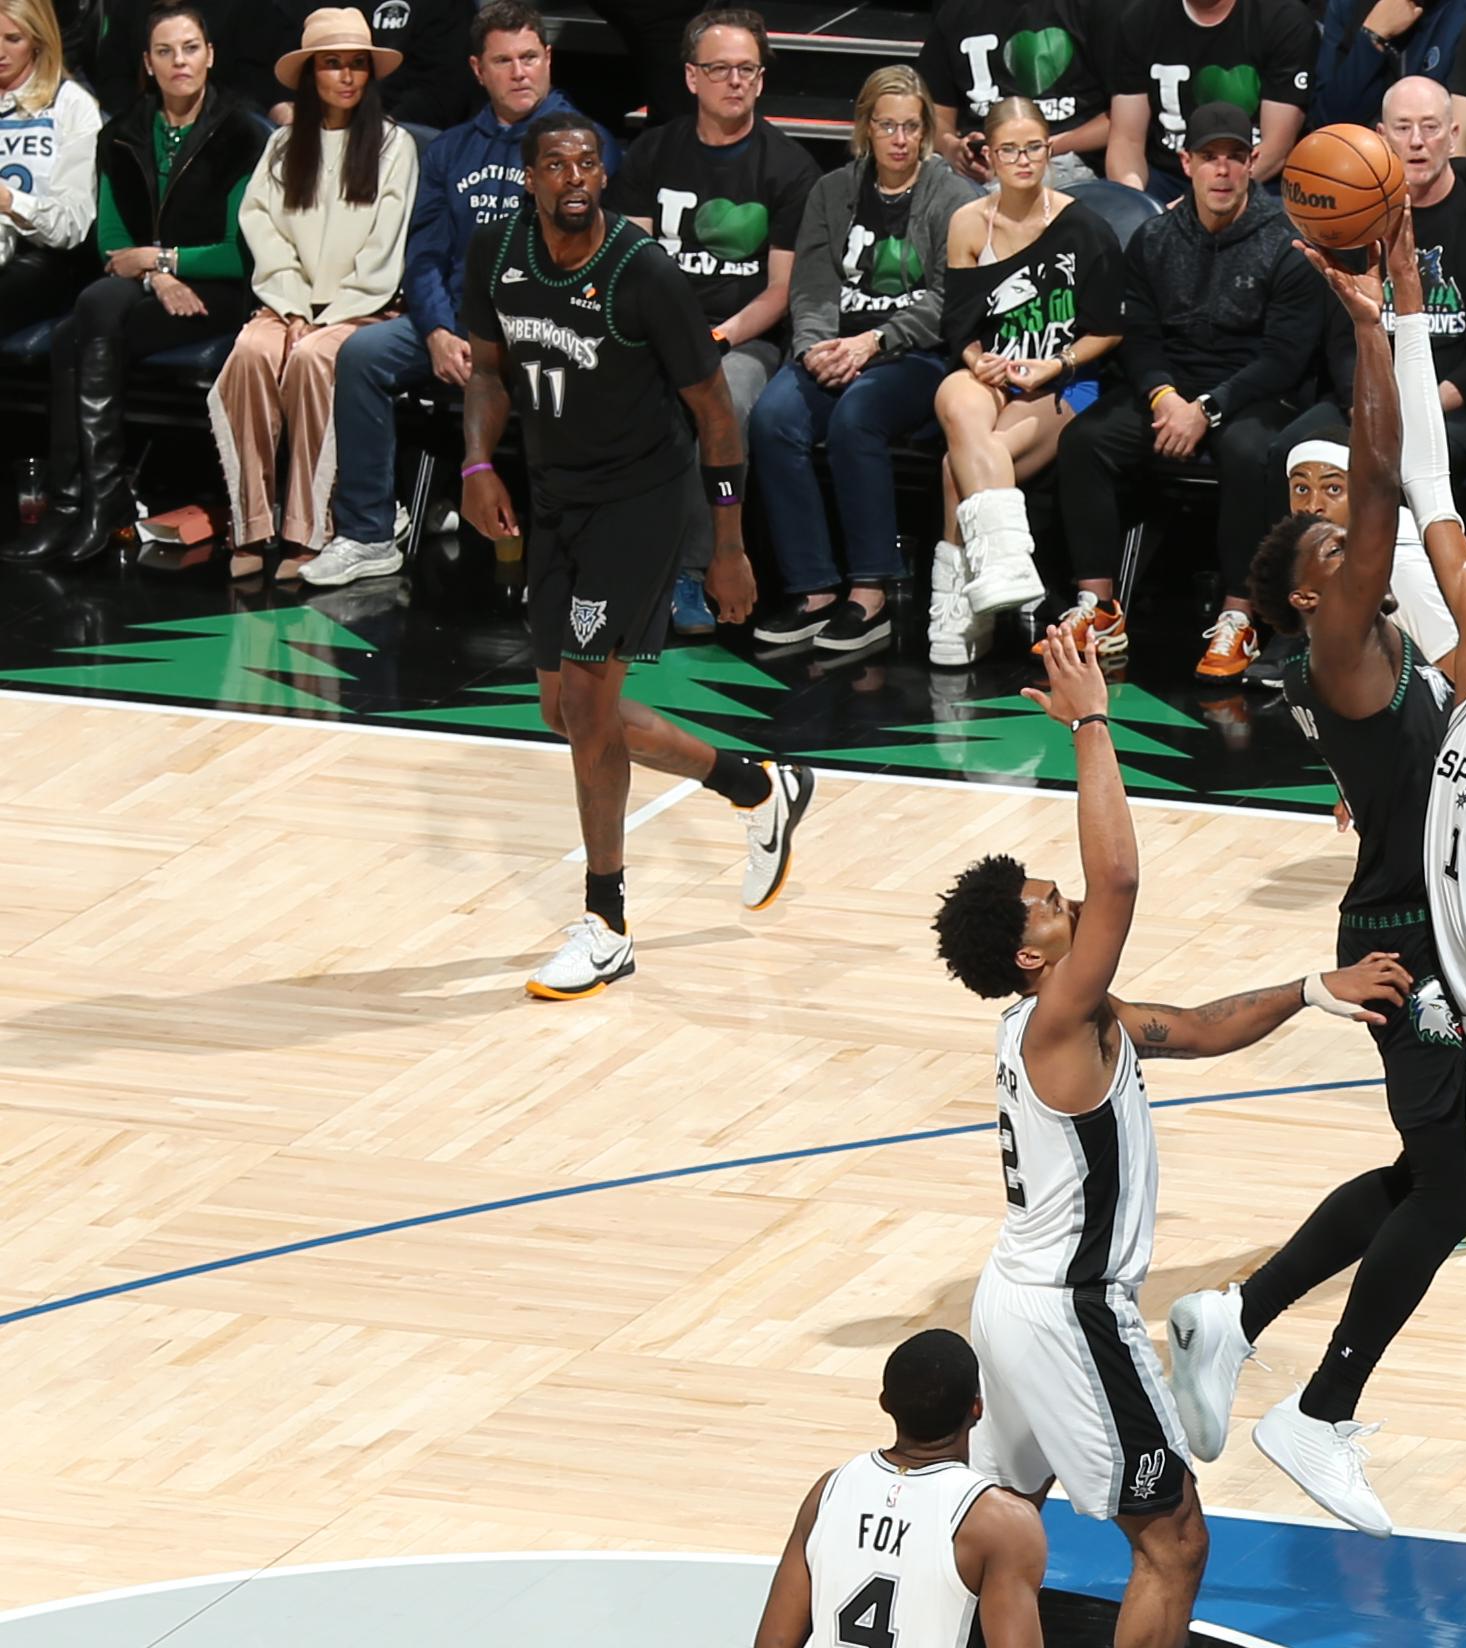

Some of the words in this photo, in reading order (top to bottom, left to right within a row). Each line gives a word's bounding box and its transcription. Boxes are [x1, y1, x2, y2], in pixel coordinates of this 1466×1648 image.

[1151, 64, 1190, 131] I
[570, 296, 601, 312] sezzle
[521, 361, 566, 418] 11
[718, 481, 732, 496] 11
[1444, 826, 1461, 882] 1
[858, 1513, 911, 1557] FOX
[834, 1571, 901, 1648] 4
